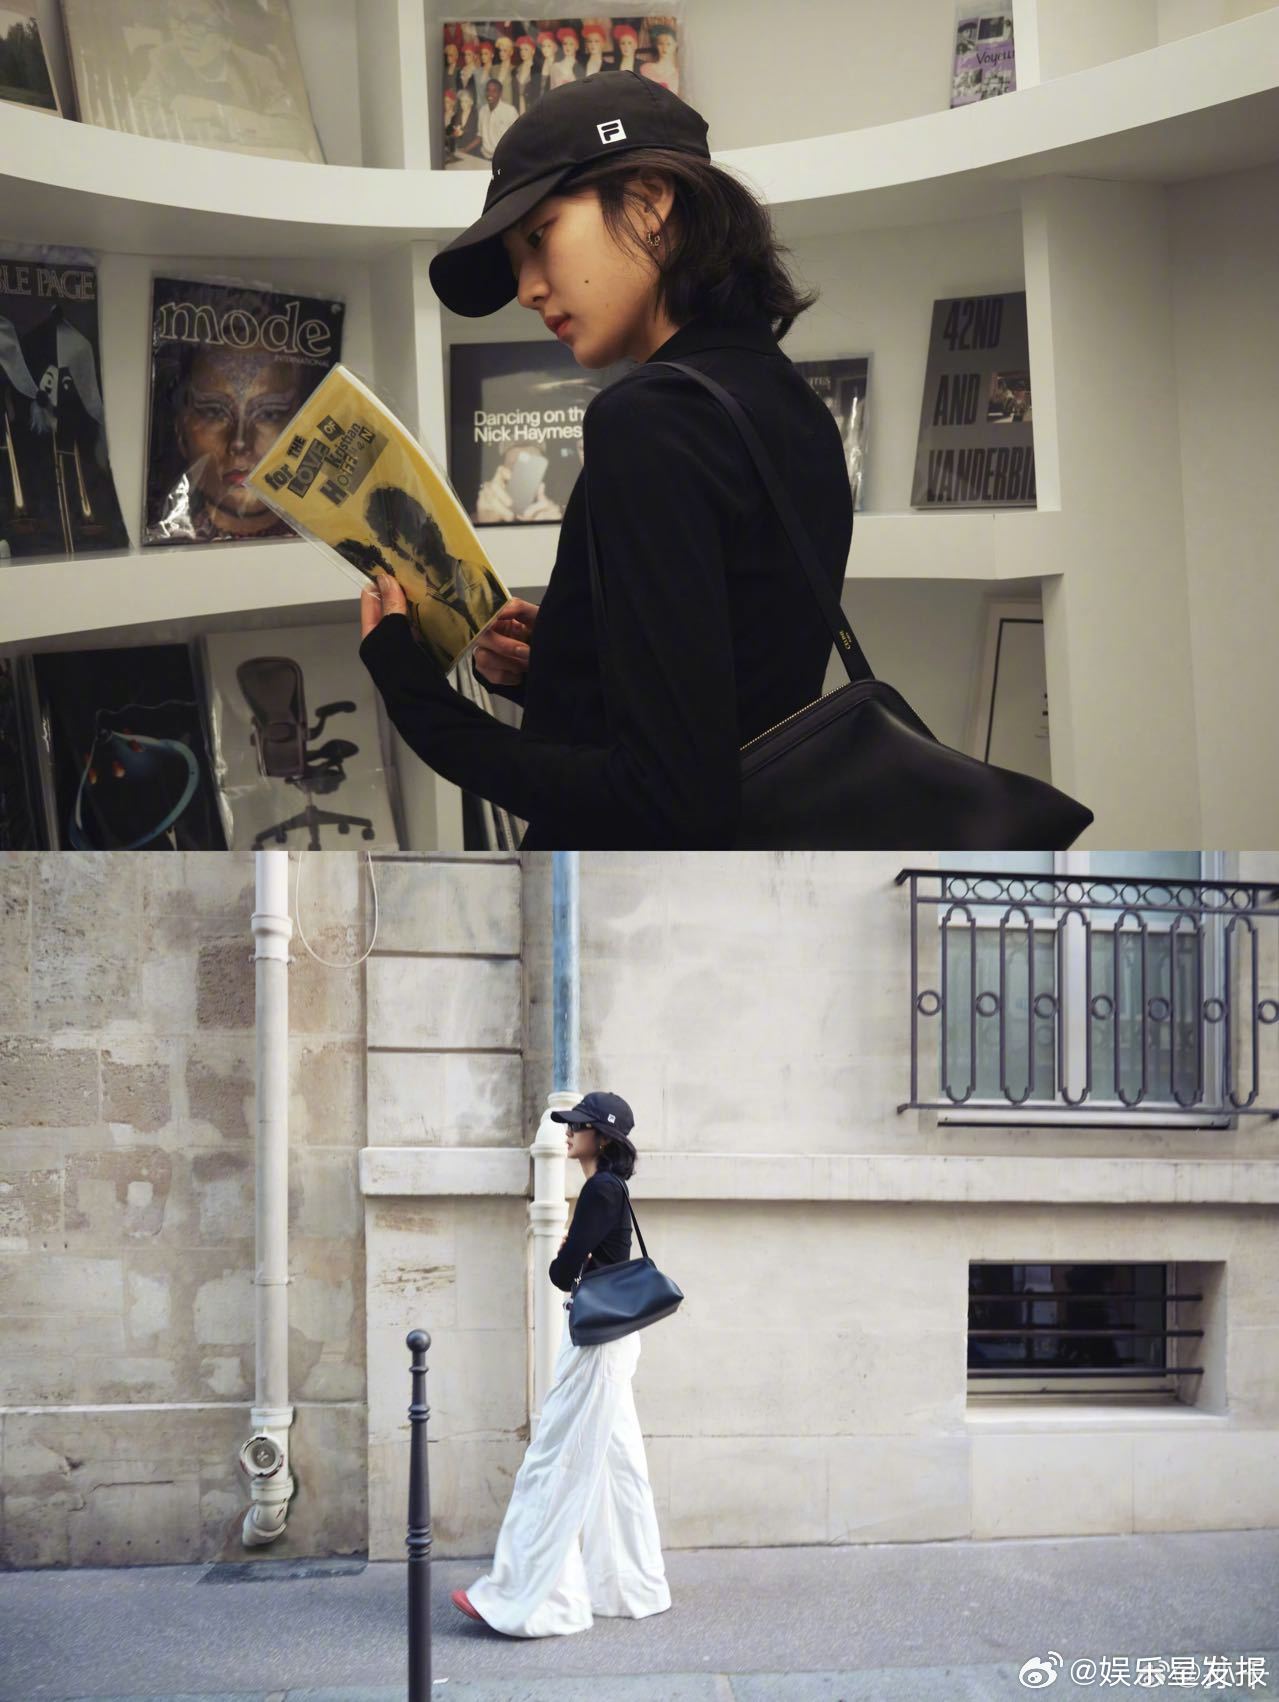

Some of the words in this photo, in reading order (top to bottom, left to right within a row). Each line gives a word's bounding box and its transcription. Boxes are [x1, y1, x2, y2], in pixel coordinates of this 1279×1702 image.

[0, 264, 32, 296] LE
[36, 268, 96, 300] PAGE
[159, 301, 332, 357] mode
[944, 297, 1005, 351] 42ND
[474, 409, 540, 427] Dancing
[543, 409, 566, 423] on
[932, 373, 981, 426] AND
[474, 426, 511, 443] Nick
[514, 425, 583, 443] Haymes
[264, 463, 293, 491] for
[286, 434, 306, 458] THE
[288, 438, 330, 498] LOVE
